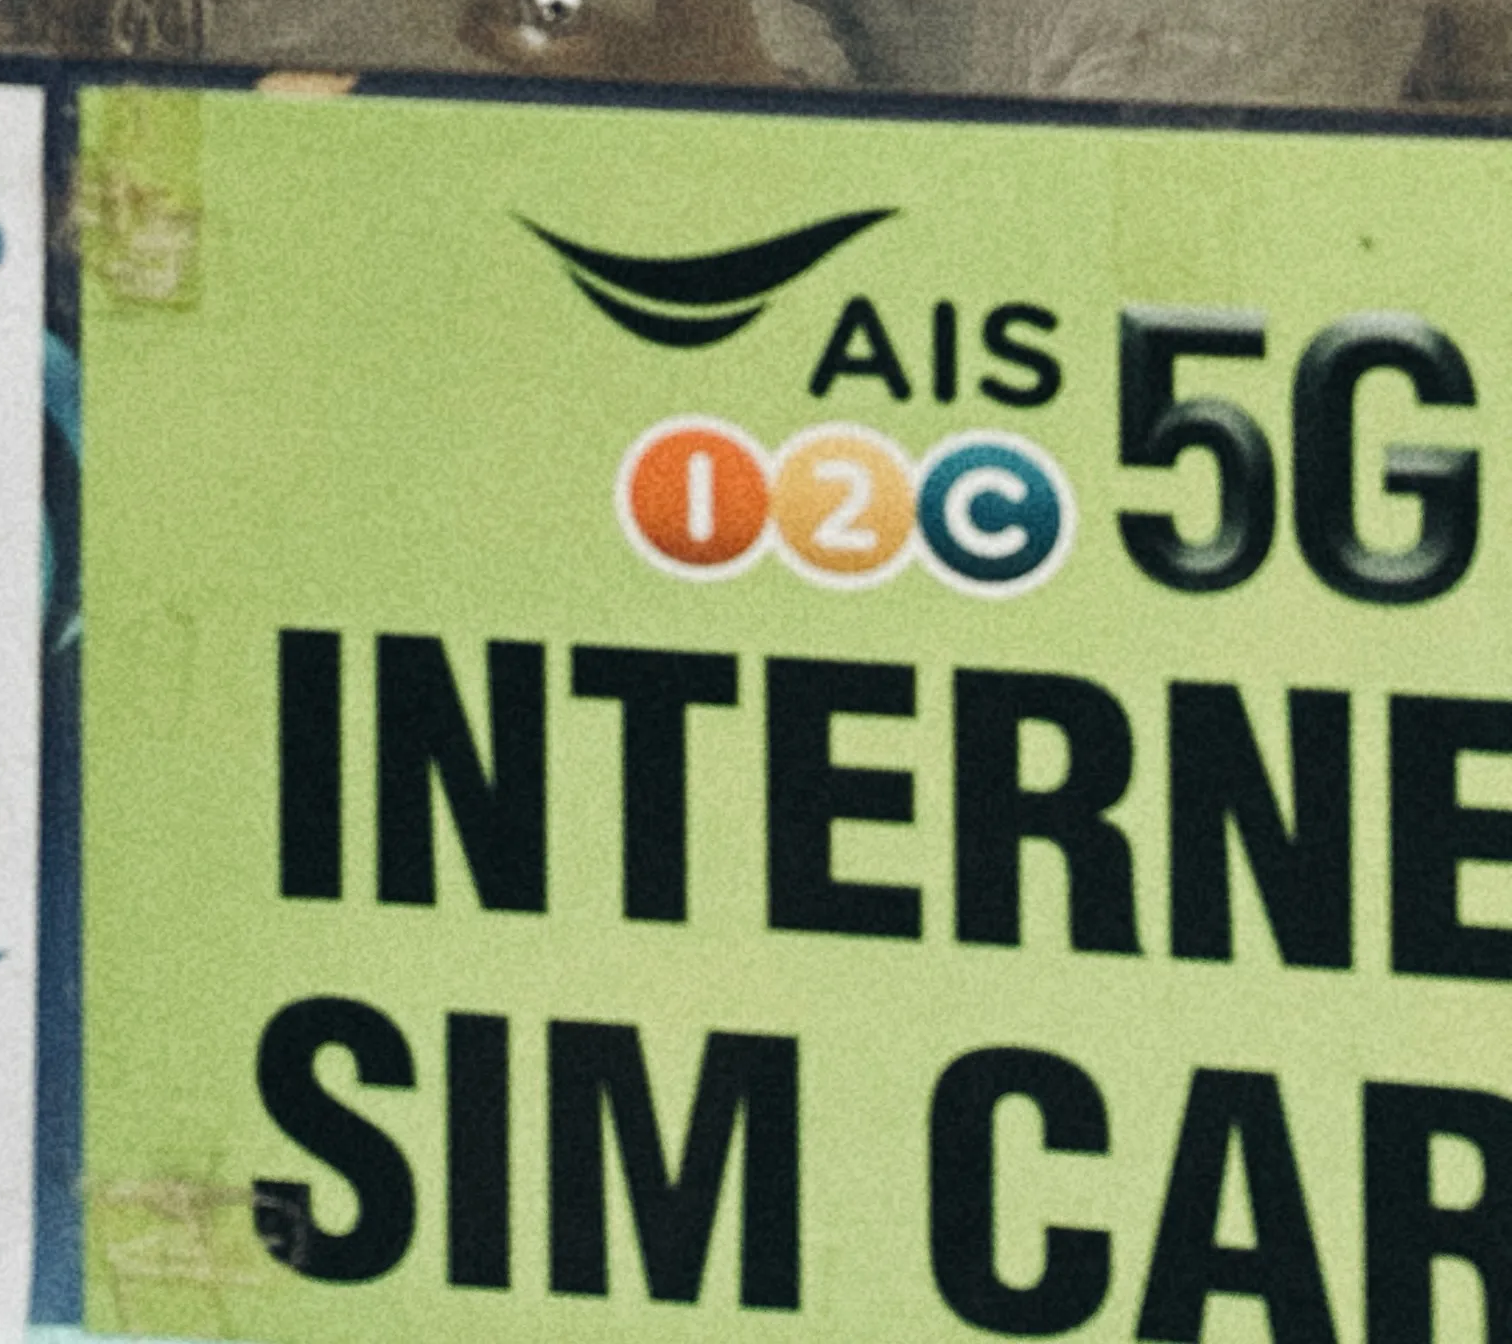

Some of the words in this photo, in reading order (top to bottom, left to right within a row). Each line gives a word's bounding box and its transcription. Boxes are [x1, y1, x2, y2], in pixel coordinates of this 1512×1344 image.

[807, 294, 1066, 409] AIS
[1115, 302, 1482, 609] 5G
[277, 626, 1512, 984] INTERNE
[250, 994, 803, 1312] SIM
